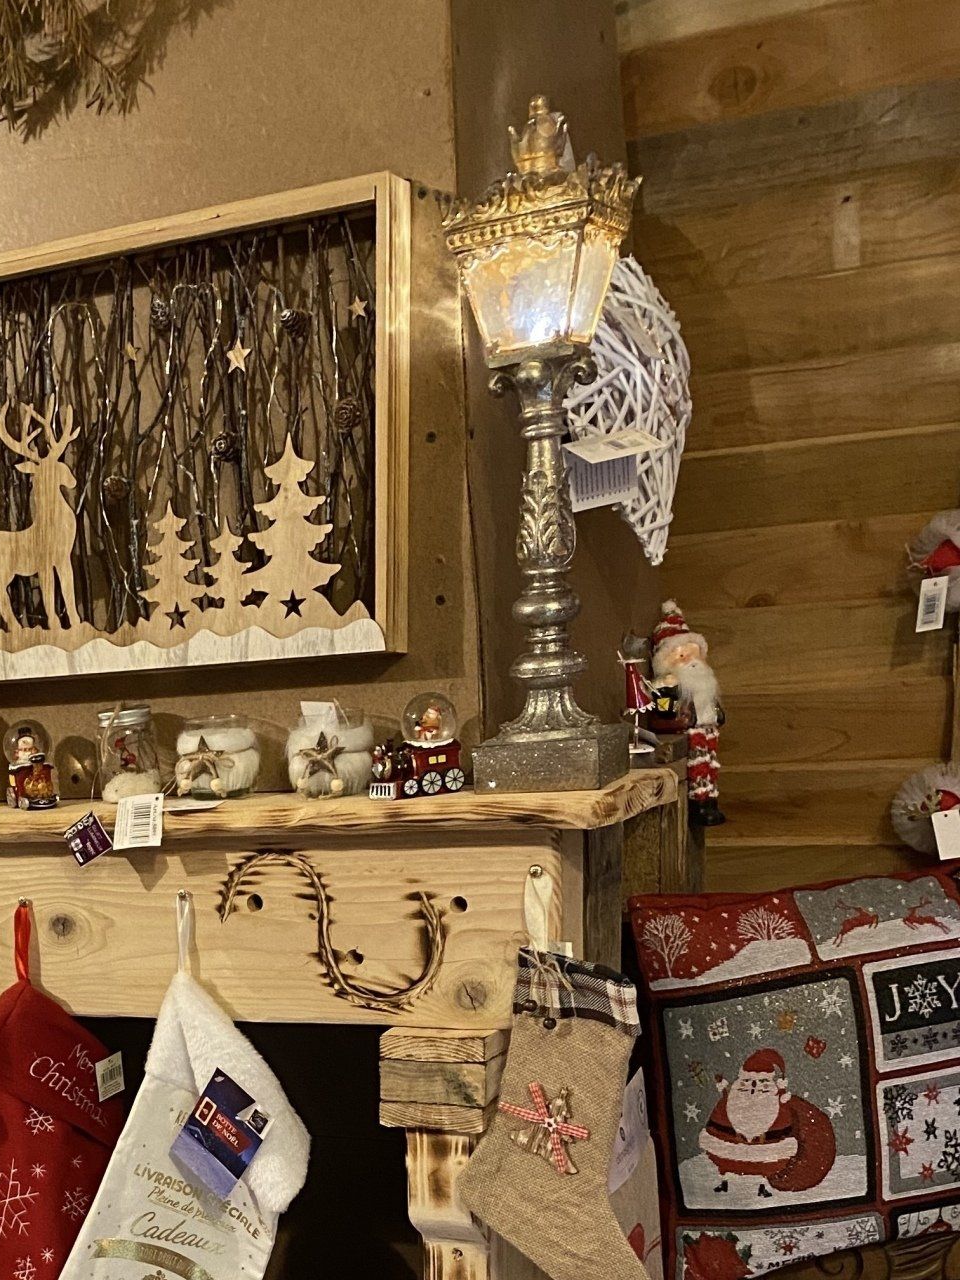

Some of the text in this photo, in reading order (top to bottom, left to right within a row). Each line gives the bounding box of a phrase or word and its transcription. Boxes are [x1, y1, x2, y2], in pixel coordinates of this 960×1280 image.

[133, 1162, 203, 1200] LIVRAISON
[147, 1185, 179, 1209] Pleine
[181, 1200, 194, 1215] de
[129, 1211, 227, 1254] Cadeaux
